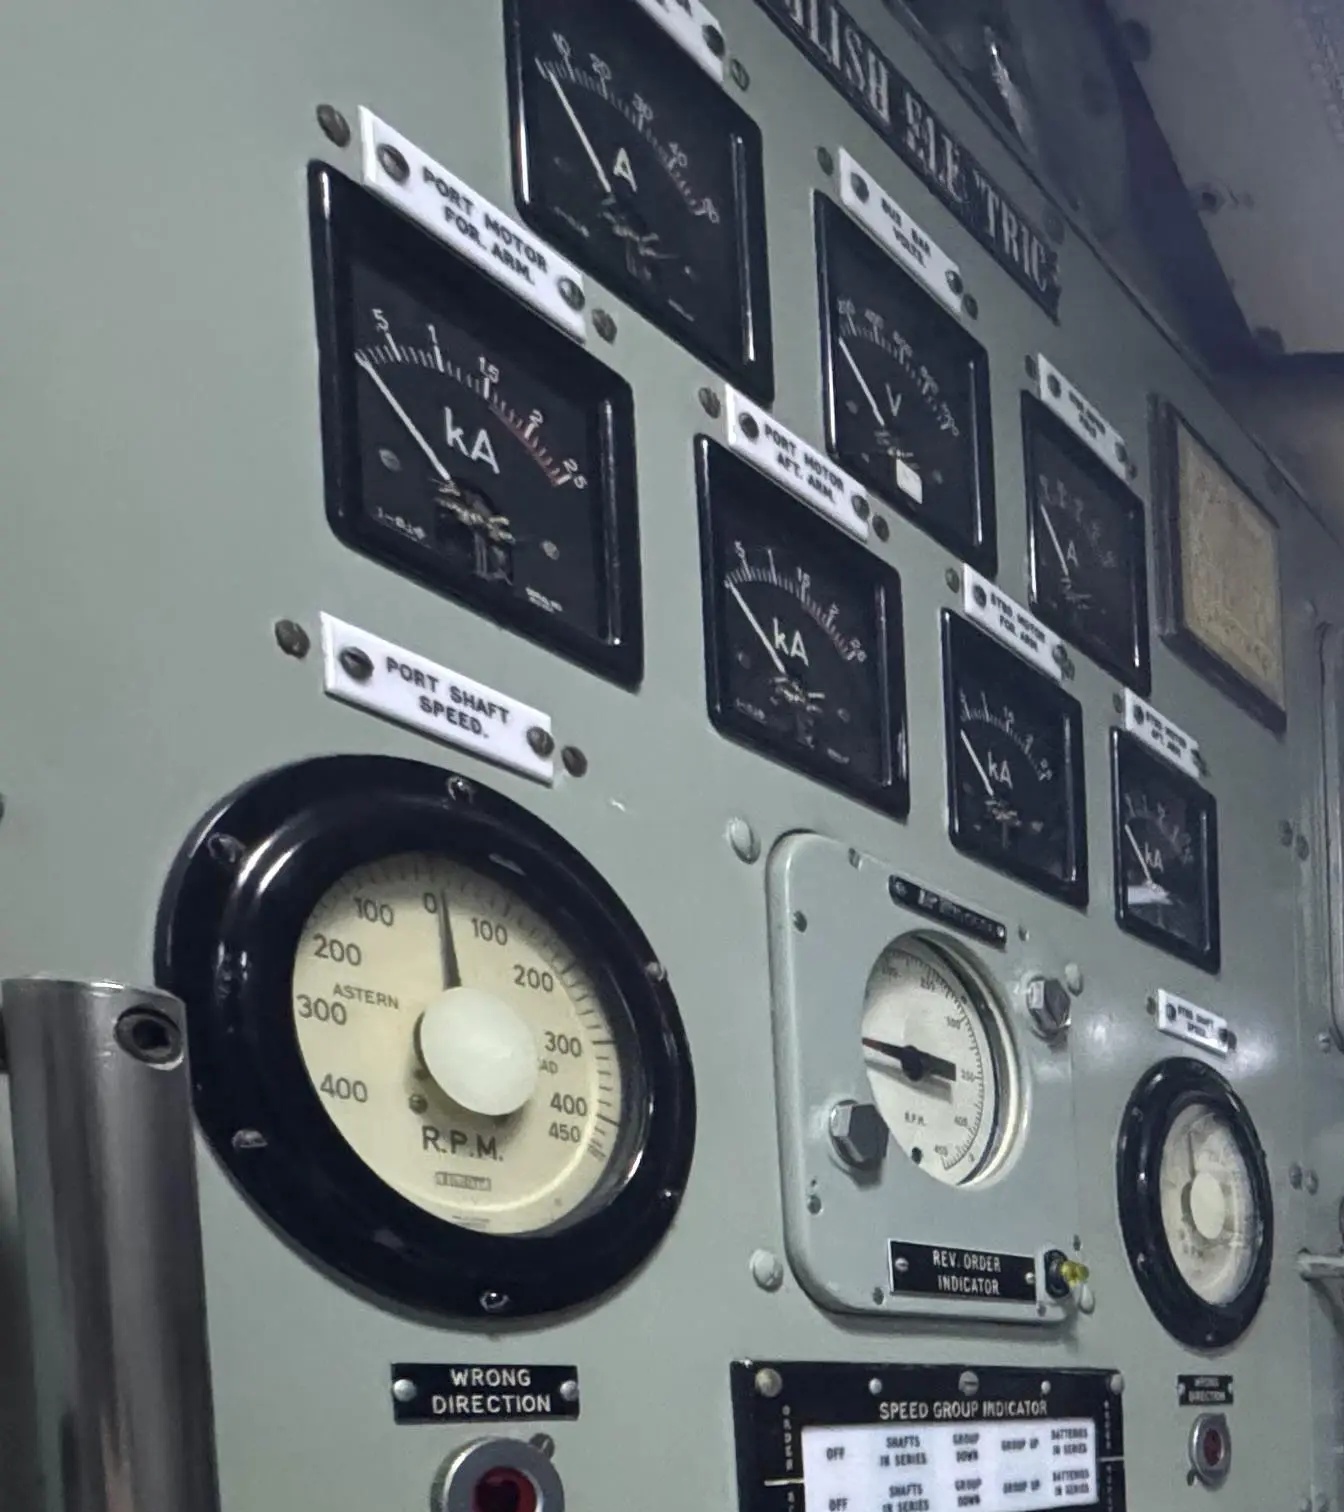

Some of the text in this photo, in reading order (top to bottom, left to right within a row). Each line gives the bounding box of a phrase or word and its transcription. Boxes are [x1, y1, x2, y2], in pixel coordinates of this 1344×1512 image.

[613, 147, 637, 192] A
[423, 166, 548, 273] PORT MOTOR
[885, 382, 902, 417] V
[444, 406, 500, 474] kA
[764, 423, 844, 493] PORT MOTOR
[1017, 607, 1046, 643] MOTOR
[772, 616, 809, 667] kA
[385, 656, 510, 725] PORT SHAFT
[418, 697, 489, 739] SPEED.
[988, 751, 1013, 790] kA
[354, 897, 394, 927] 100
[423, 892, 437, 913] 0
[472, 917, 508, 946] 100
[313, 933, 362, 967] 200
[513, 964, 554, 992] 200
[333, 983, 399, 1010] ASTERN
[297, 994, 347, 1026] 300
[544, 1031, 583, 1058] 300
[320, 1073, 368, 1103] 400
[550, 1092, 587, 1117] 400
[548, 1121, 581, 1143] 450
[421, 1125, 504, 1161] R.P.M.
[963, 1252, 1001, 1272] ORDER
[938, 1274, 1000, 1295] INDICATOR
[450, 1368, 531, 1388] WRONG
[432, 1394, 551, 1414] DIRECTION
[879, 1400, 1048, 1420] SPEED GROUP INDICATOR
[886, 1436, 921, 1448] SHAFTS
[953, 1433, 980, 1446] GROUP
[1001, 1438, 1039, 1451] GROUP UP
[1051, 1428, 1088, 1440] BATTERIES
[826, 1447, 845, 1461] OFF
[880, 1452, 928, 1466] IN SERIES
[956, 1450, 979, 1463] DOWN
[1063, 1443, 1087, 1455] SERIES
[954, 1479, 983, 1492] GROUP
[1052, 1469, 1089, 1482] BATTERIES
[889, 1484, 923, 1497] SHAFTS
[1003, 1480, 1041, 1494] GROUP UP
[1065, 1483, 1089, 1496] SERIES
[829, 1498, 848, 1512] OFF
[957, 1494, 981, 1508] DOWN
